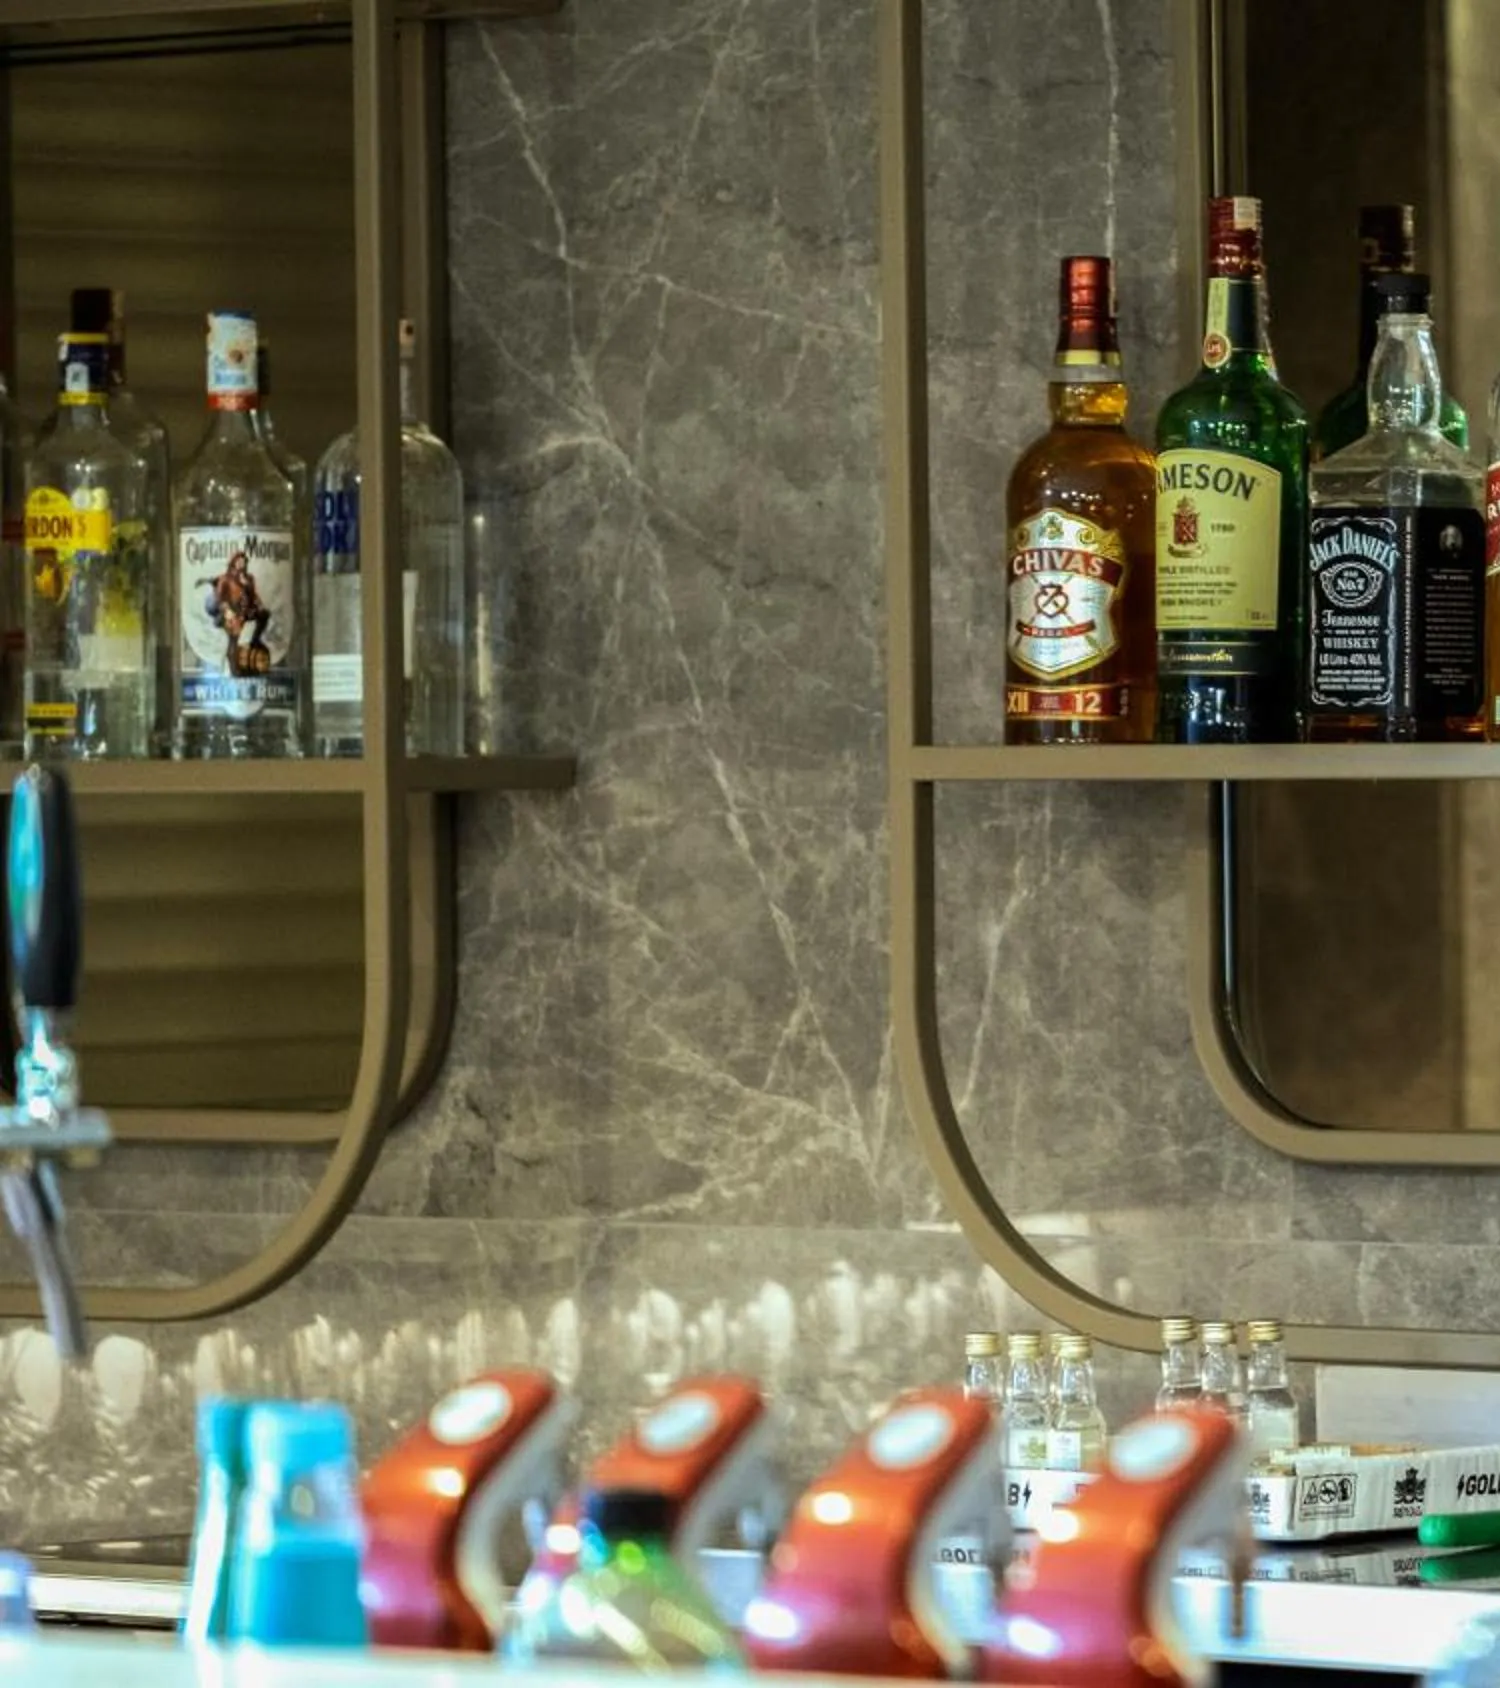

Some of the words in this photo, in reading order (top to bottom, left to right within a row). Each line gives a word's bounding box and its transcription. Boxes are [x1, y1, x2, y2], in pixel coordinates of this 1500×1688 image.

[186, 537, 239, 566] Captain
[1309, 534, 1342, 572] JACK
[1341, 525, 1401, 574] DANIEL'S
[1013, 551, 1105, 576] CHIVAS
[1323, 638, 1380, 649] WHISKEY
[1007, 691, 1029, 713] XII
[1075, 691, 1101, 714] 12
